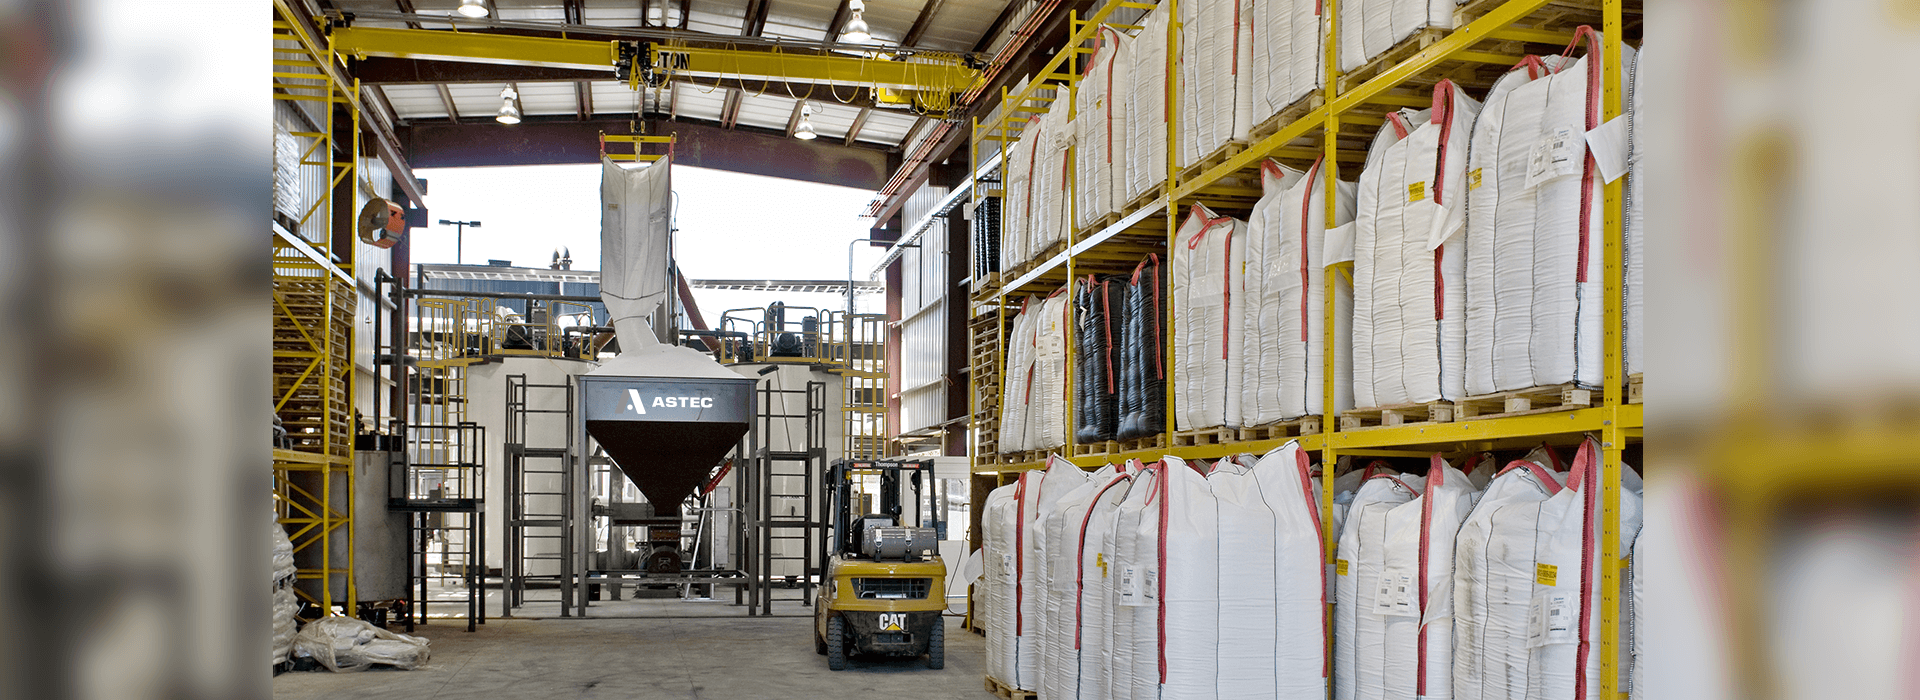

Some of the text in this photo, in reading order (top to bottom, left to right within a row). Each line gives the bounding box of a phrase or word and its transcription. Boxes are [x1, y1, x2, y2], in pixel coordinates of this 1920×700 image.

[651, 396, 713, 409] ASTEC
[875, 460, 899, 468] Thompson
[878, 612, 907, 631] CAT
